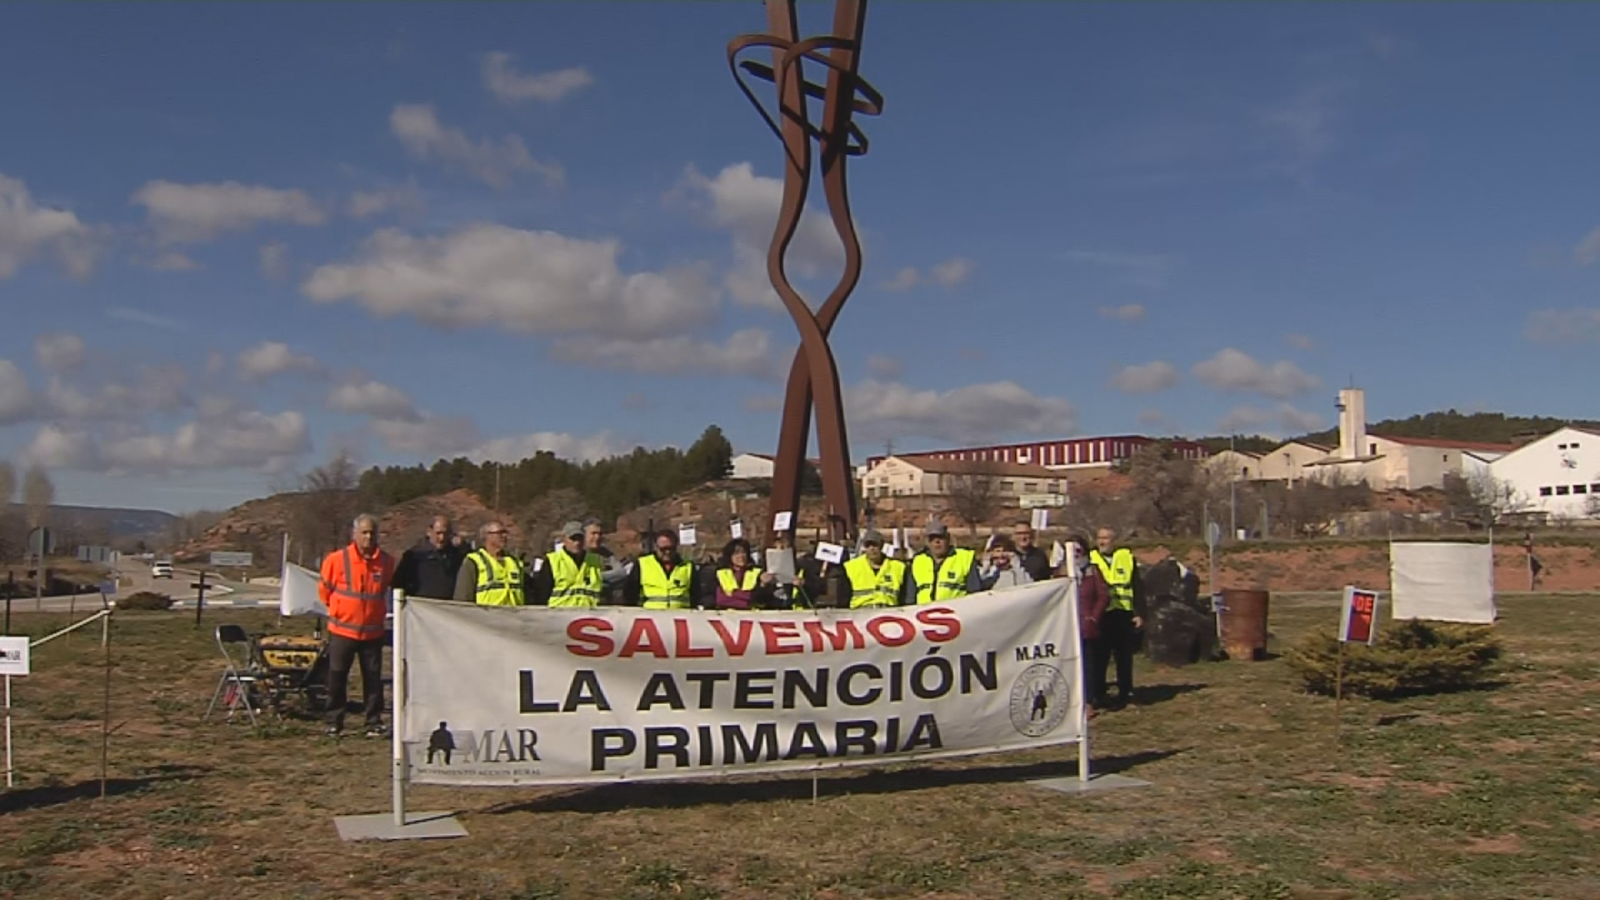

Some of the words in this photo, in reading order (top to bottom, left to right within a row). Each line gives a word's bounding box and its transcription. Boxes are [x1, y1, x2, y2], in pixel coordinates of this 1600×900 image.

[566, 606, 961, 659] SALVEMOS
[1015, 643, 1060, 662] M.A.R.
[519, 669, 612, 714] LA
[636, 646, 998, 712] ATENCIÓN
[463, 728, 541, 763] MAR
[590, 713, 944, 771] PRIMARIA
